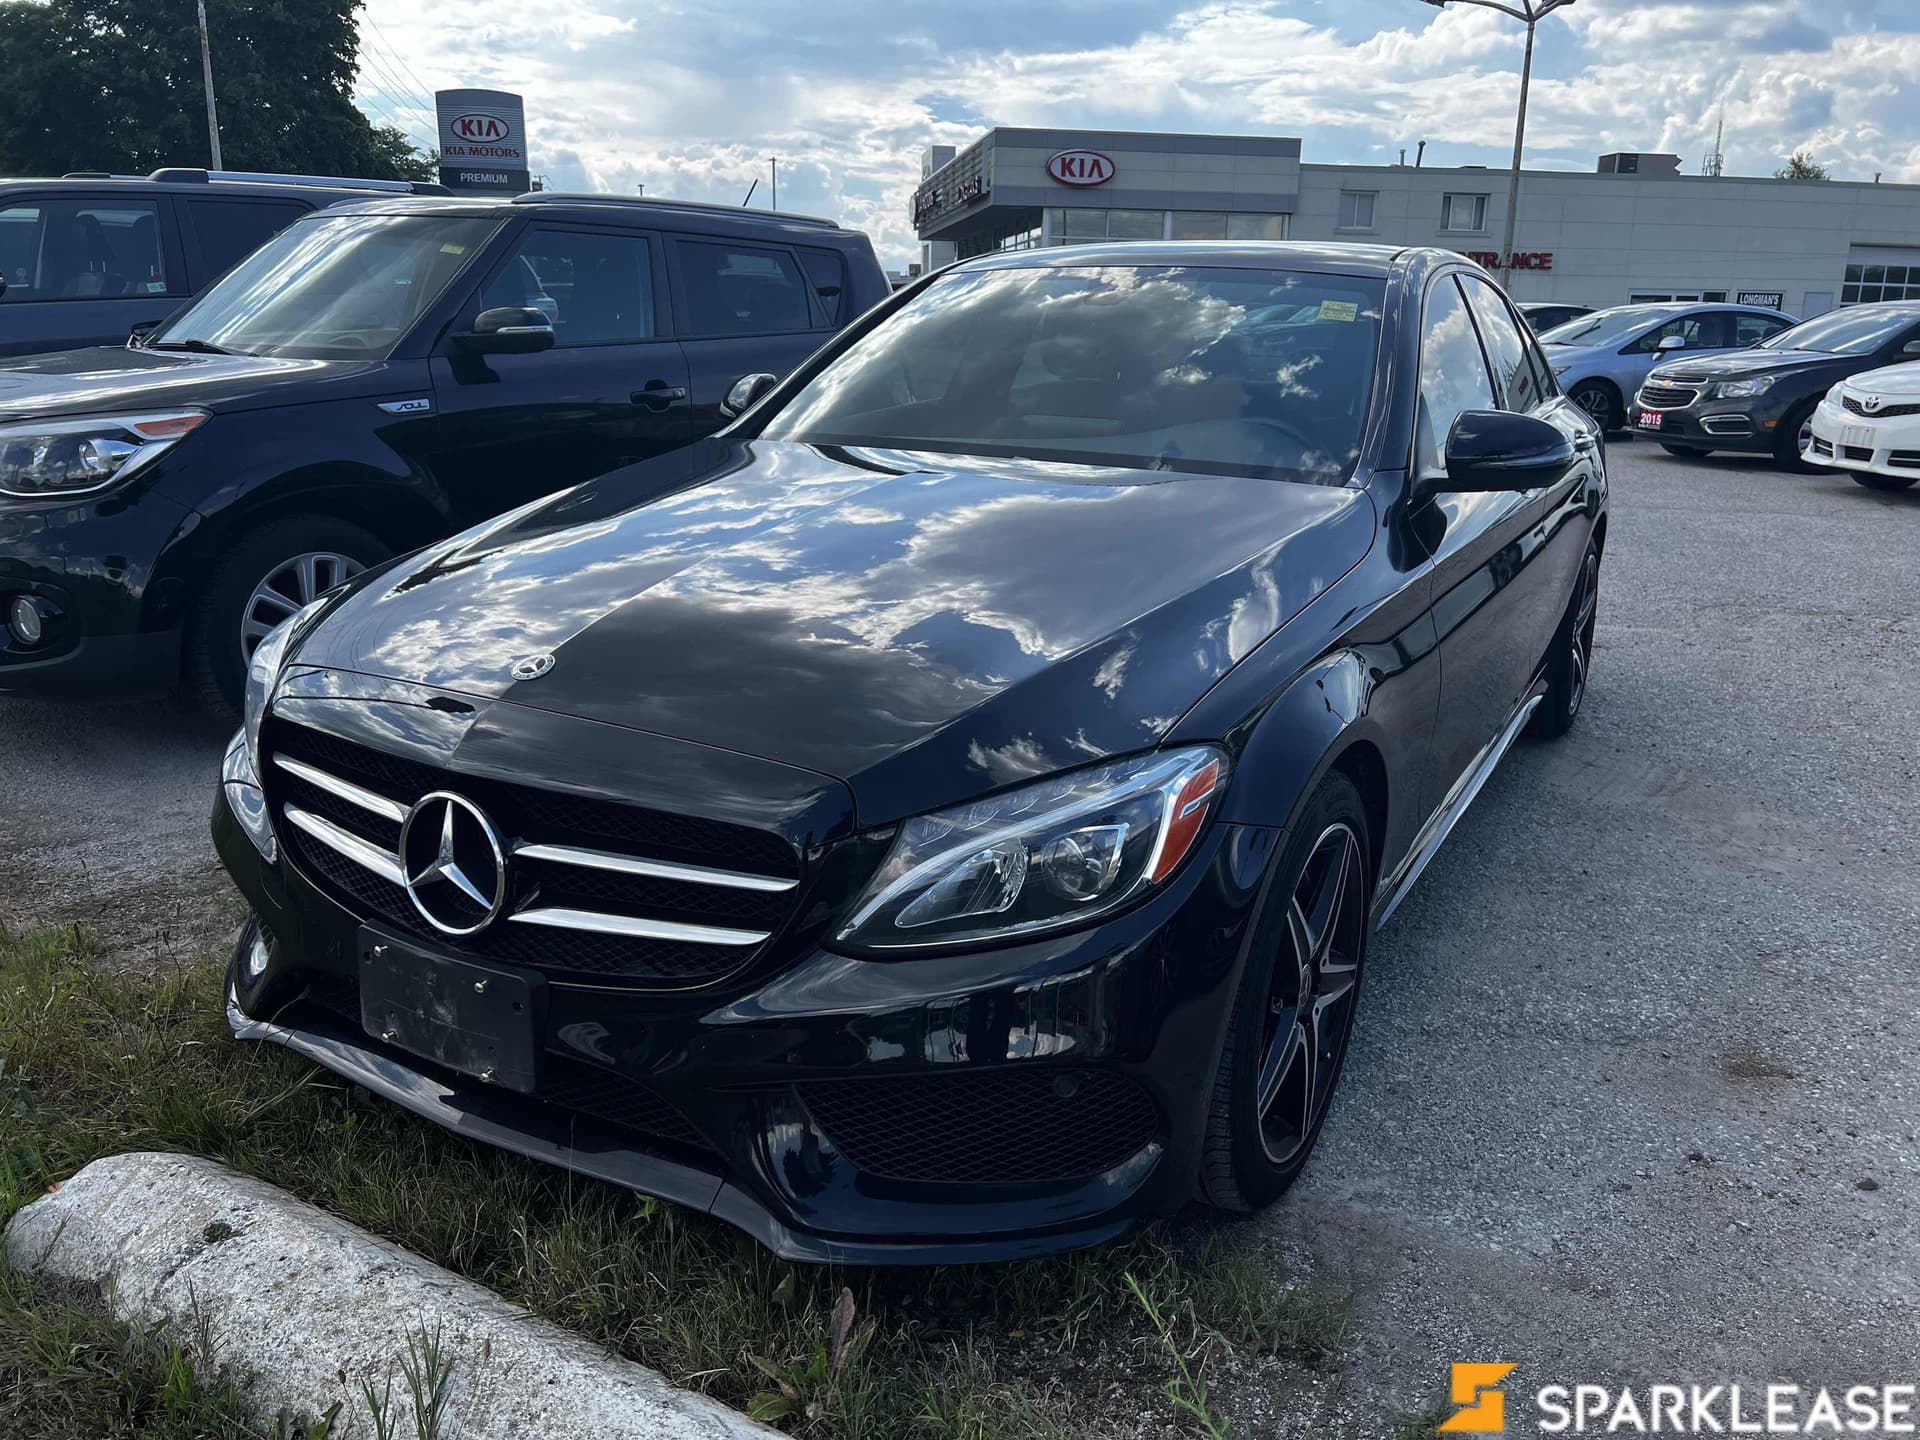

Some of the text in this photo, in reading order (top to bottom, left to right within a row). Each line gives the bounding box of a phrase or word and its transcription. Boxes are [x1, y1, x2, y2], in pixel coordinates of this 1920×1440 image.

[460, 119, 500, 137] KIA
[444, 146, 519, 158] KIA MOTORS
[1061, 157, 1104, 178] KIA
[460, 173, 508, 184] PREMIUM
[1740, 294, 1779, 305] LONGMAN'S
[1640, 412, 1662, 425] 2015
